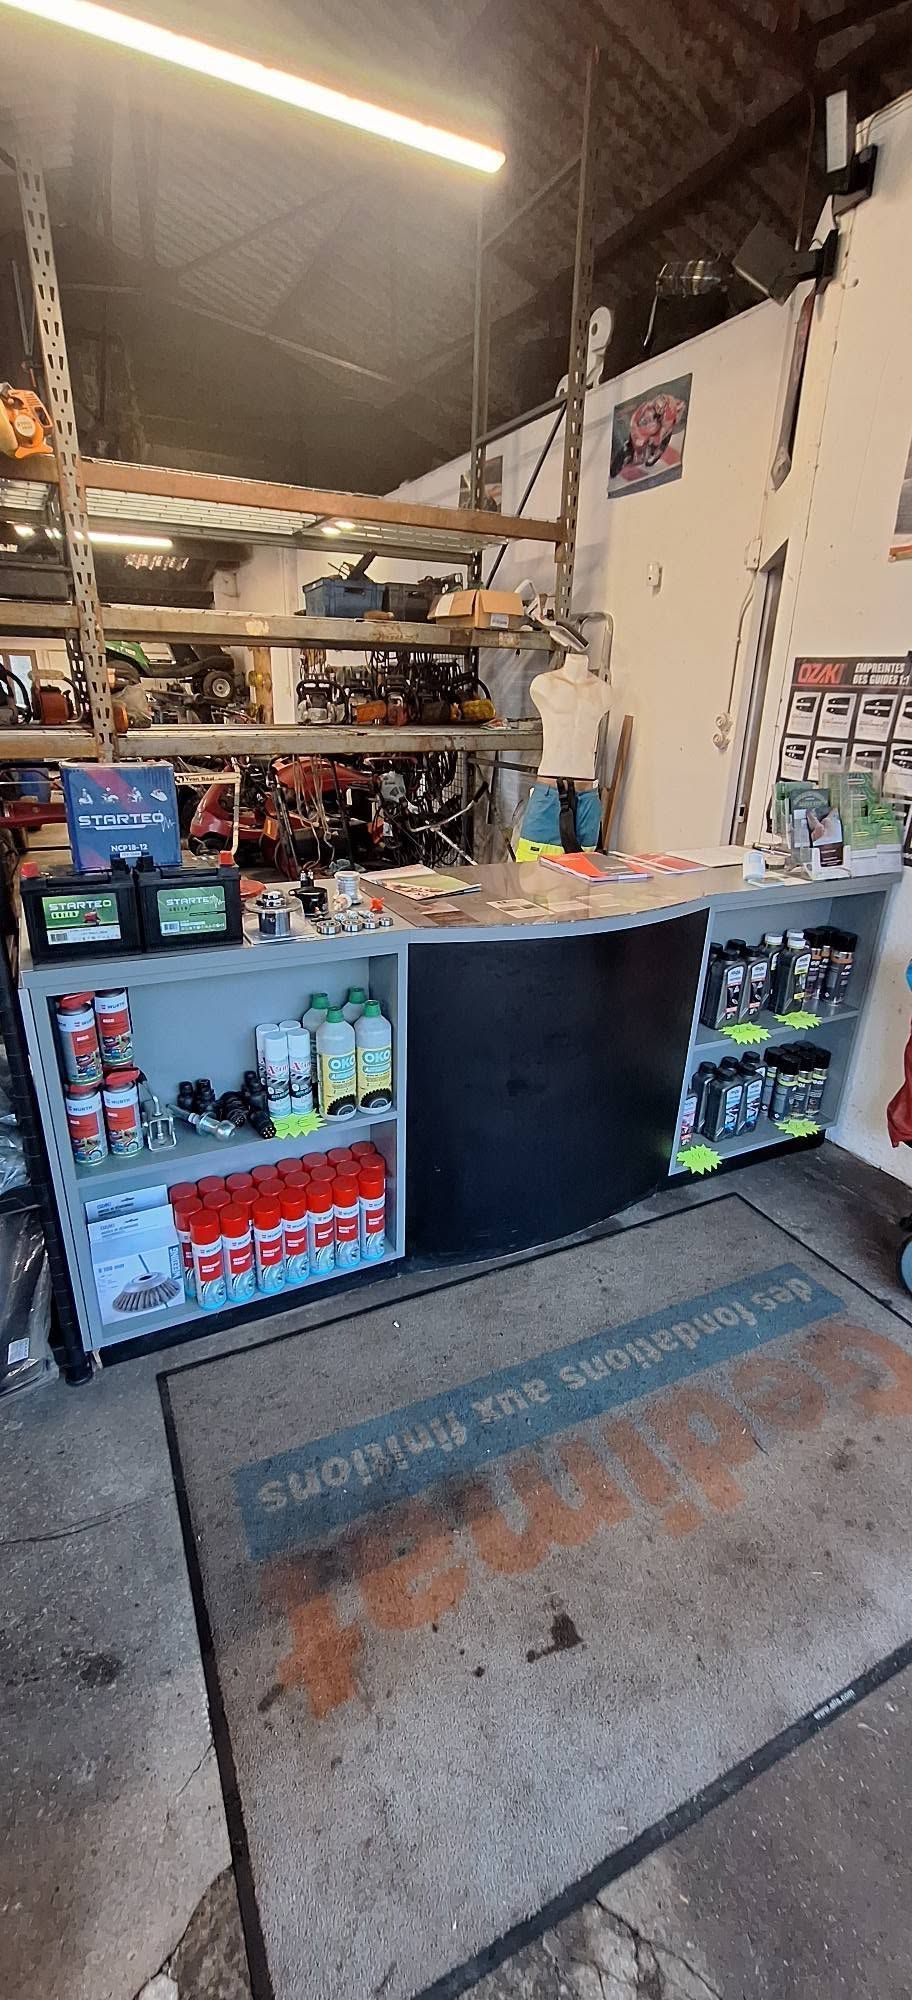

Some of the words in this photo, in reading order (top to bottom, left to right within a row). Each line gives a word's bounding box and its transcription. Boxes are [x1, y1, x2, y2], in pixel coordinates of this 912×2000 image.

[852, 674, 869, 685] DES
[869, 674, 898, 686] GUIDES
[854, 662, 906, 674] EMPREINTES
[331, 1054, 355, 1070] OKO
[365, 1049, 390, 1063] OKO
[751, 1277, 813, 1312] des
[559, 1302, 758, 1390] fondations
[472, 1379, 552, 1424] aux
[257, 1410, 468, 1513] finitions
